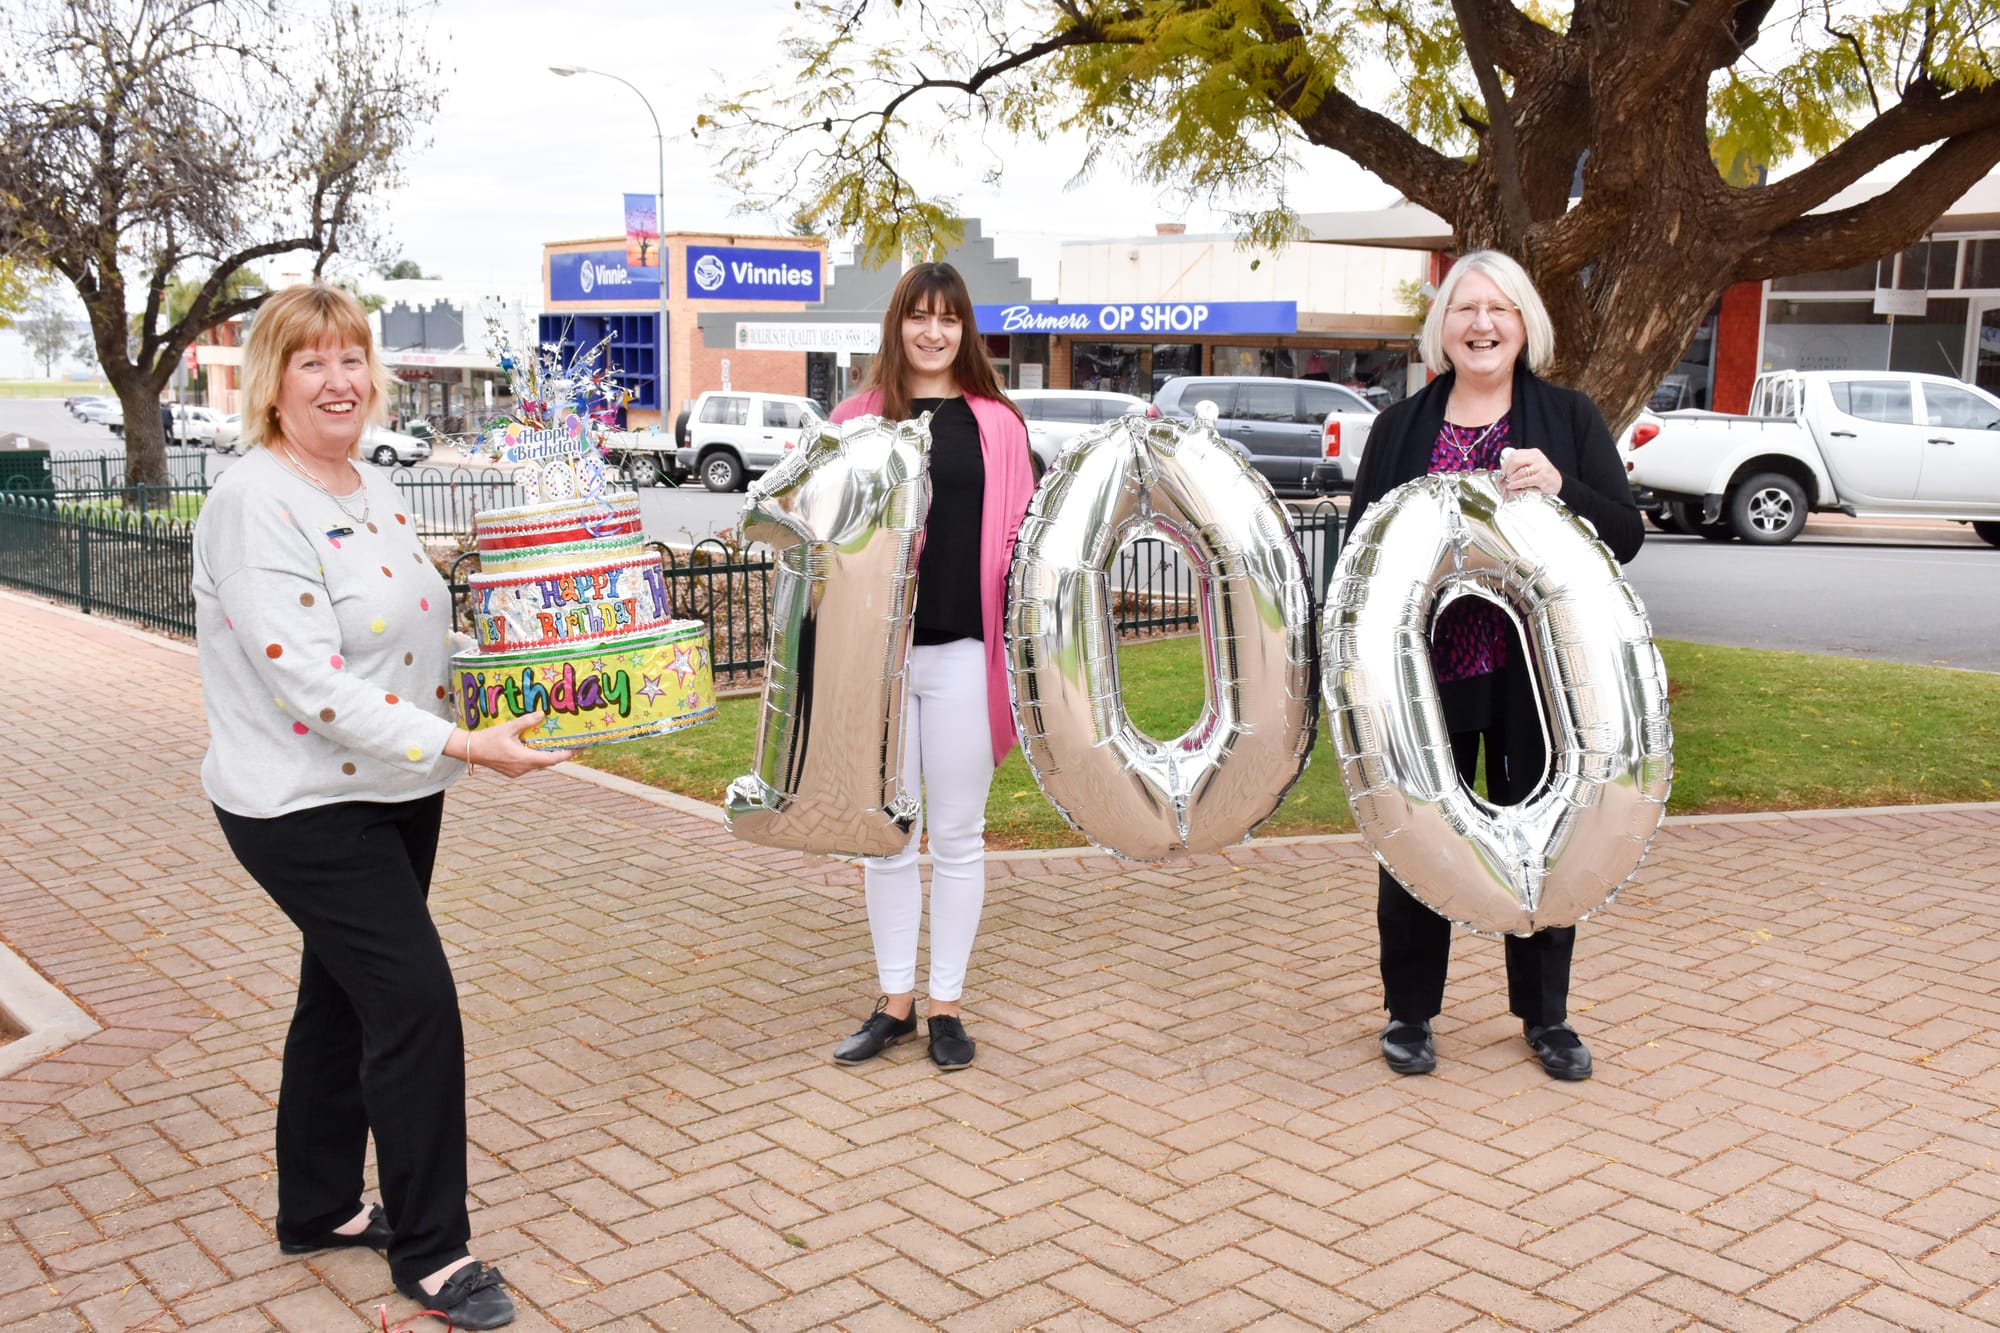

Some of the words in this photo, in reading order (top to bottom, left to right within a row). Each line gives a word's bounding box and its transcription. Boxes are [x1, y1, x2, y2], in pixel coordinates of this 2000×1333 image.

[595, 263, 632, 285] Vinnie
[731, 261, 813, 286] Vinnies
[1000, 305, 1091, 331] Barmera
[1099, 306, 1135, 331] OP
[1140, 304, 1209, 331] SHOP
[519, 427, 570, 444] Happy
[514, 436, 581, 460] Birthday
[461, 662, 632, 730] Birthday
